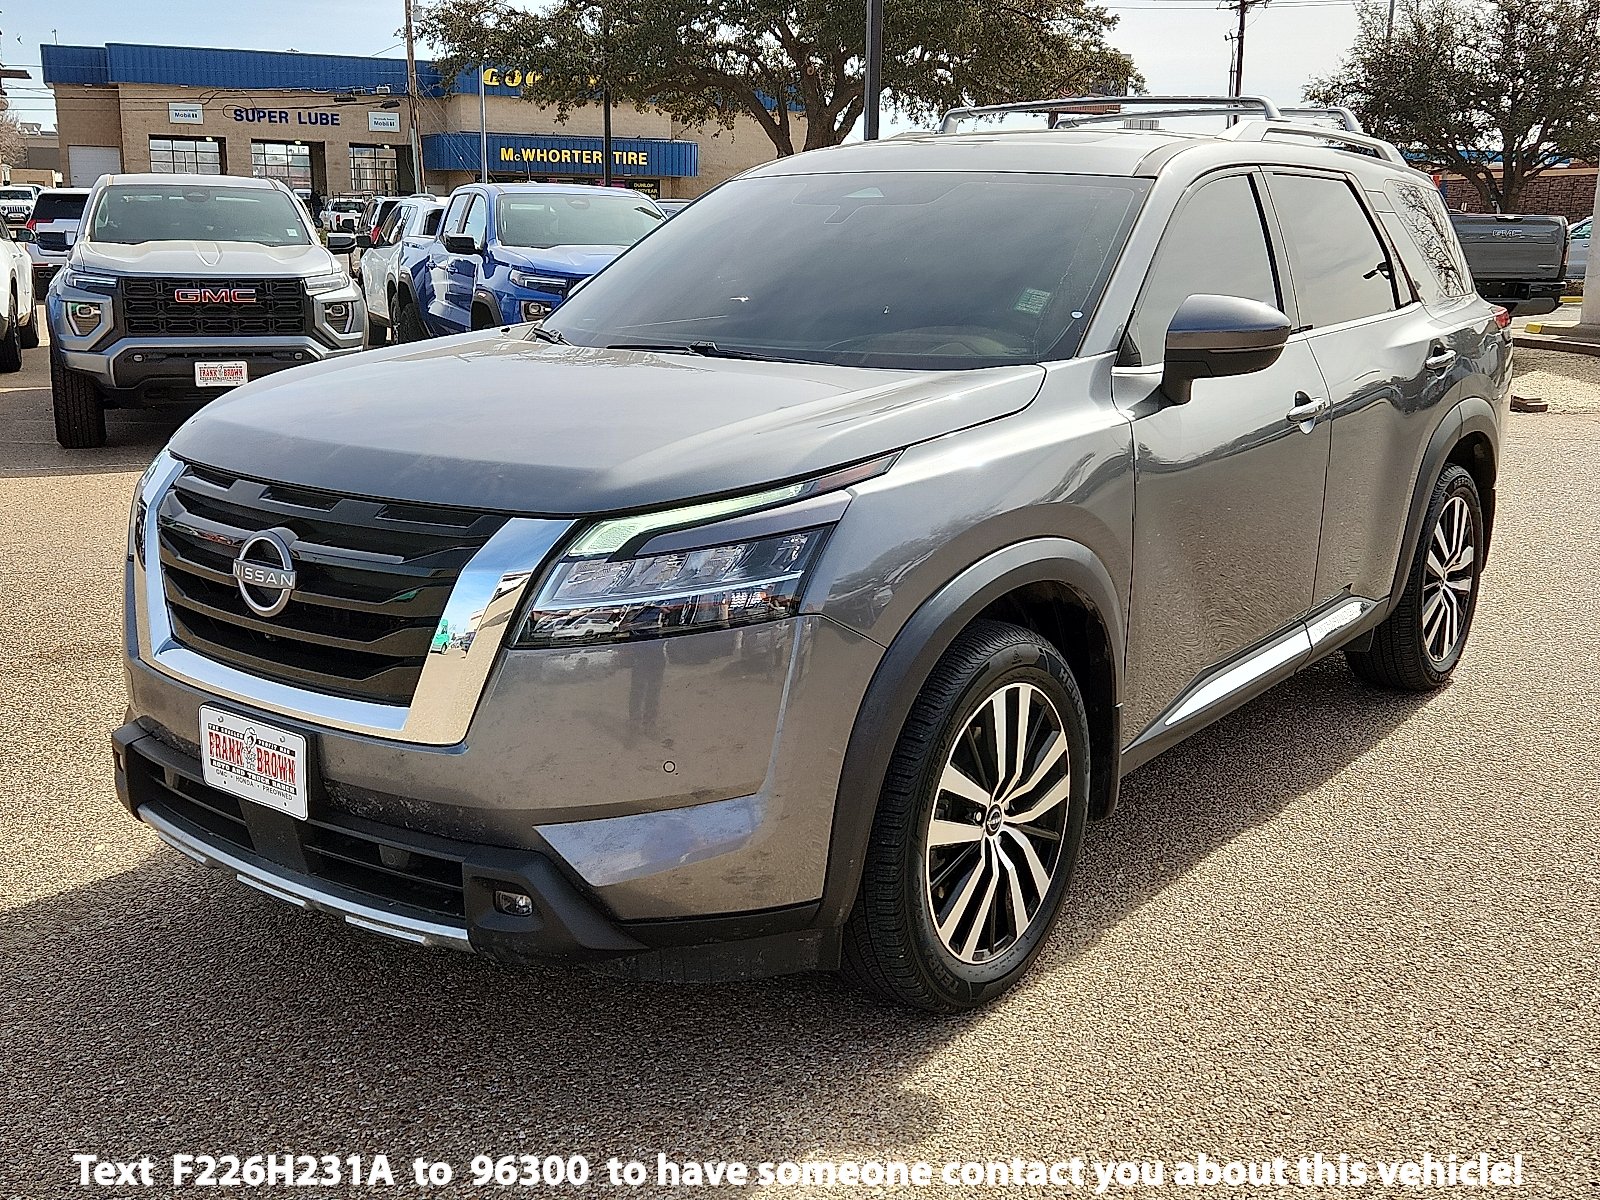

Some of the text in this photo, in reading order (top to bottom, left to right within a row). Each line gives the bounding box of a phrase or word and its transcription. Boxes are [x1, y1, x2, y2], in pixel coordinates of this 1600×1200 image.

[233, 109, 341, 126] SUPER LUBE
[612, 151, 648, 166] TIRE
[175, 288, 257, 303] GMC
[233, 562, 293, 587] NISSAN
[208, 731, 297, 785] FRANK BROWN
[235, 776, 255, 788] HONDA
[262, 785, 293, 801] PREOWNED
